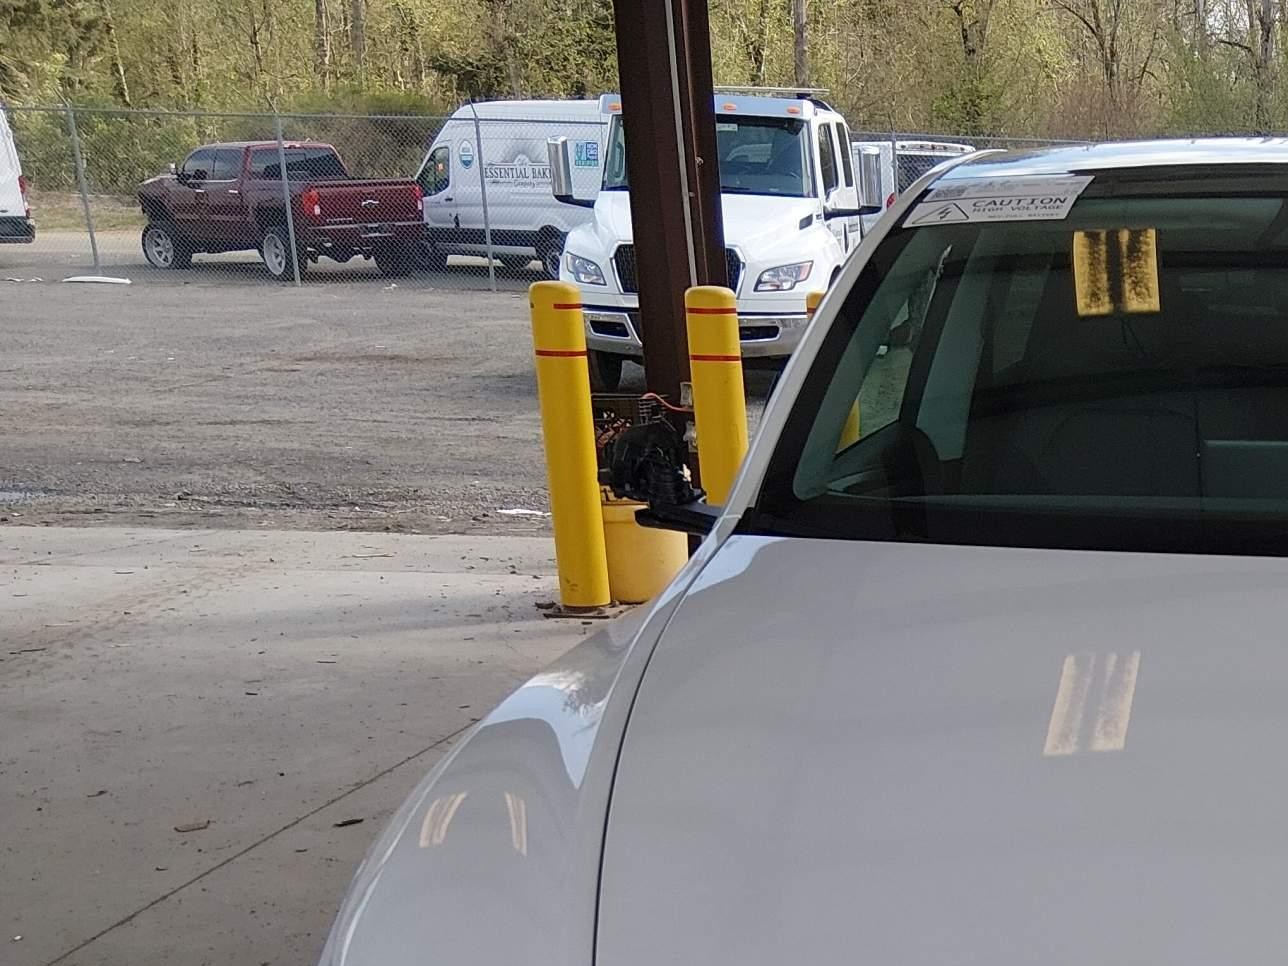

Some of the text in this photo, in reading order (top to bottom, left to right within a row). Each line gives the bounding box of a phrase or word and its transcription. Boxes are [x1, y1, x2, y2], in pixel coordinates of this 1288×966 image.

[484, 167, 530, 180] ESSENTIAL
[972, 196, 1068, 208] CAUTION
[1010, 204, 1063, 212] VOLTAGE
